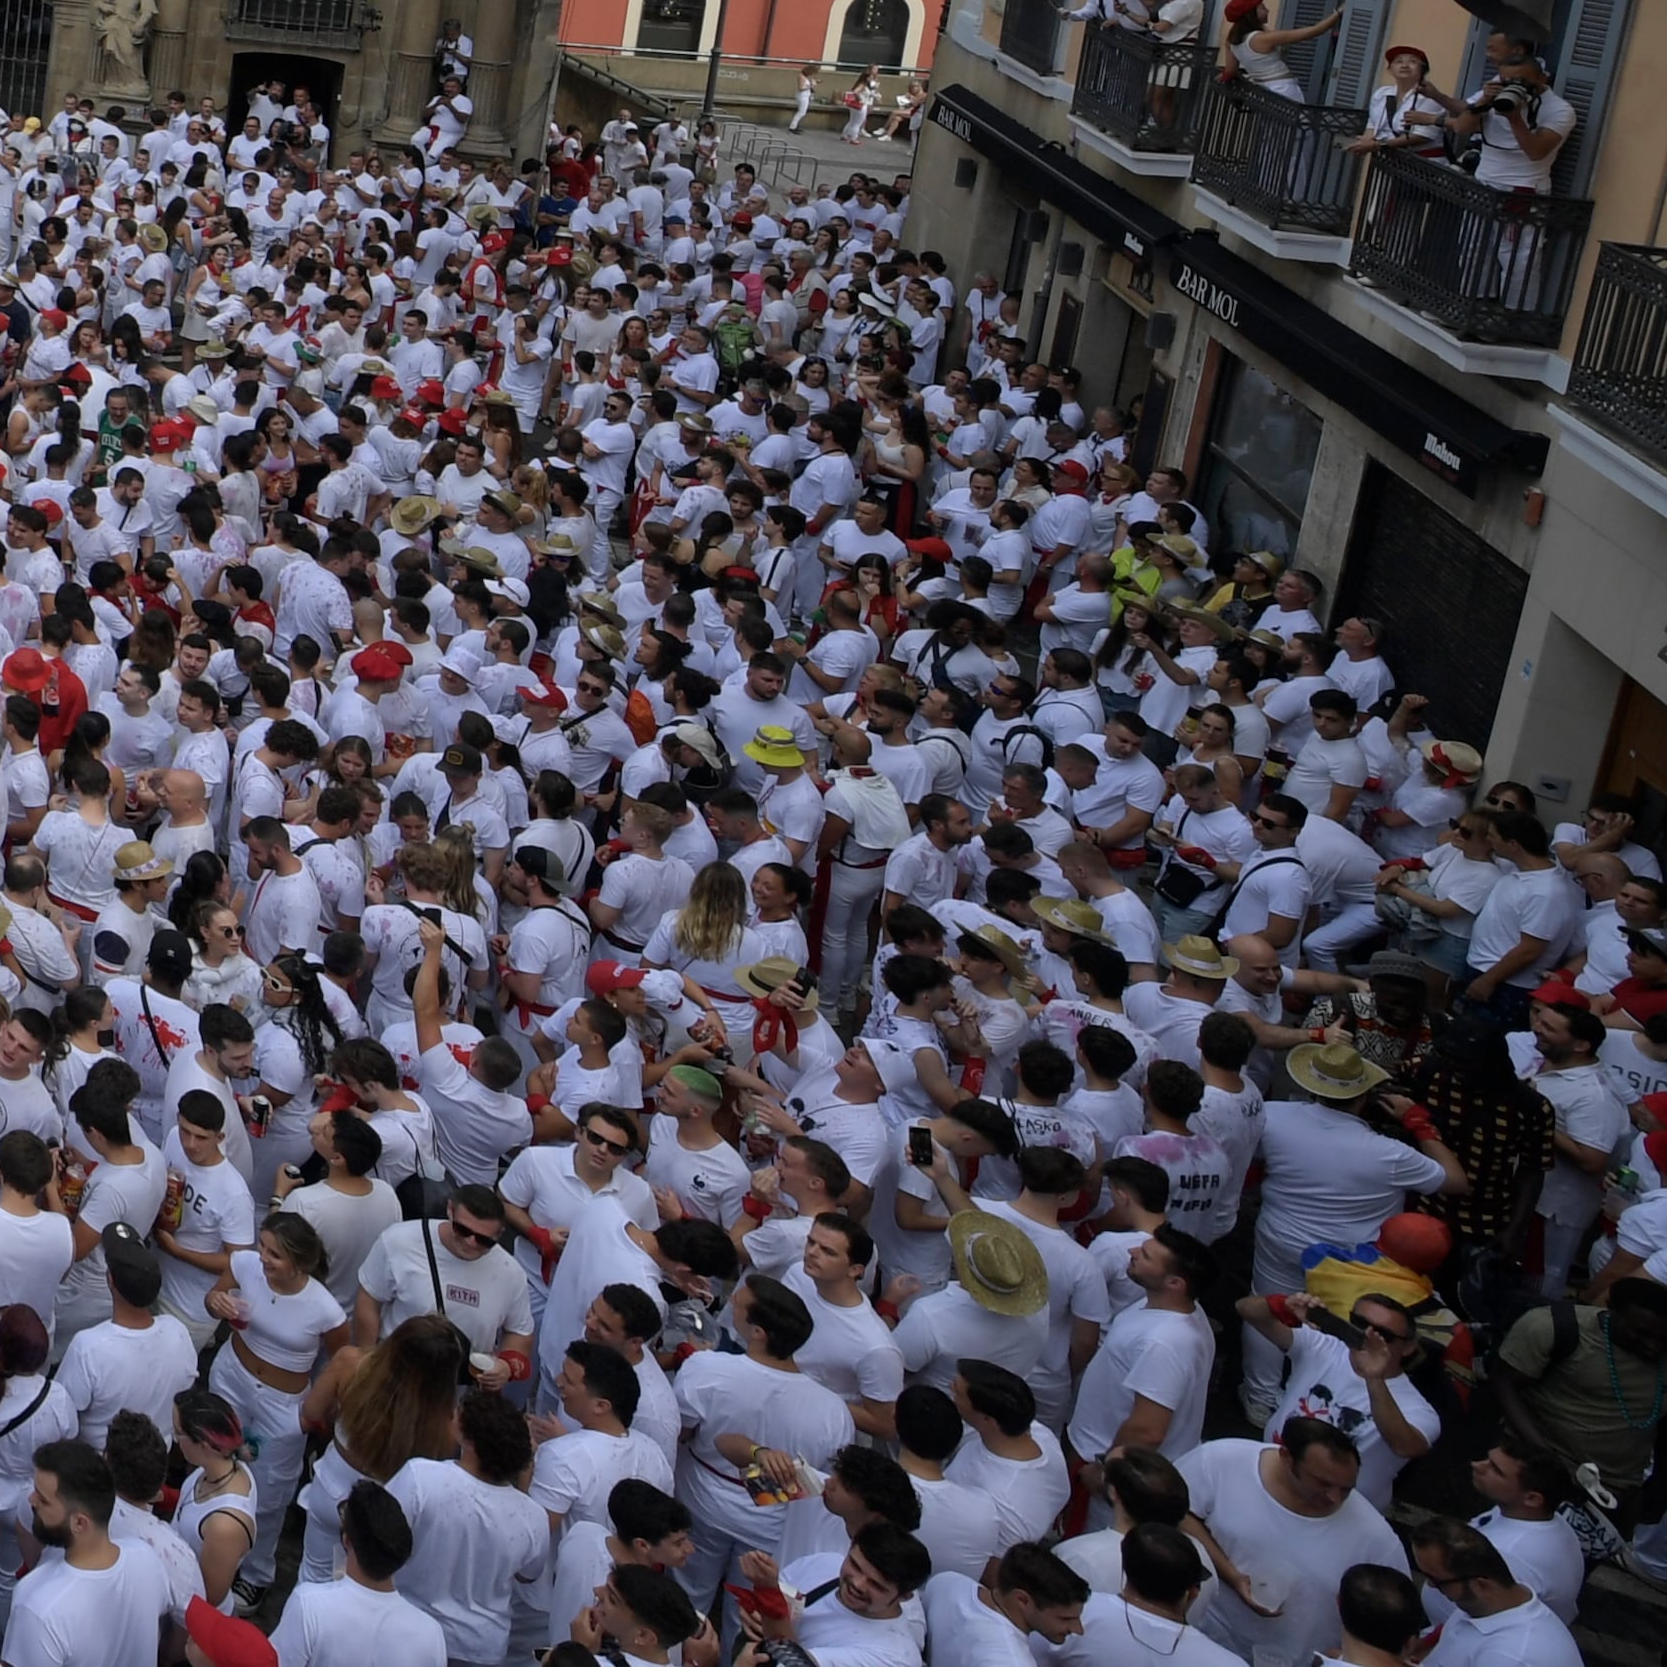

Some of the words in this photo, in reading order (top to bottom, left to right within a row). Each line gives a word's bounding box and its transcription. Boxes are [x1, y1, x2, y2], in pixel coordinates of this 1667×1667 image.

[937, 105, 954, 131] BAR
[955, 118, 972, 143] MOL
[1176, 264, 1206, 306] BAR
[1207, 284, 1239, 327] MOL
[1424, 432, 1461, 471] Mahou
[450, 1288, 477, 1303] KITH
